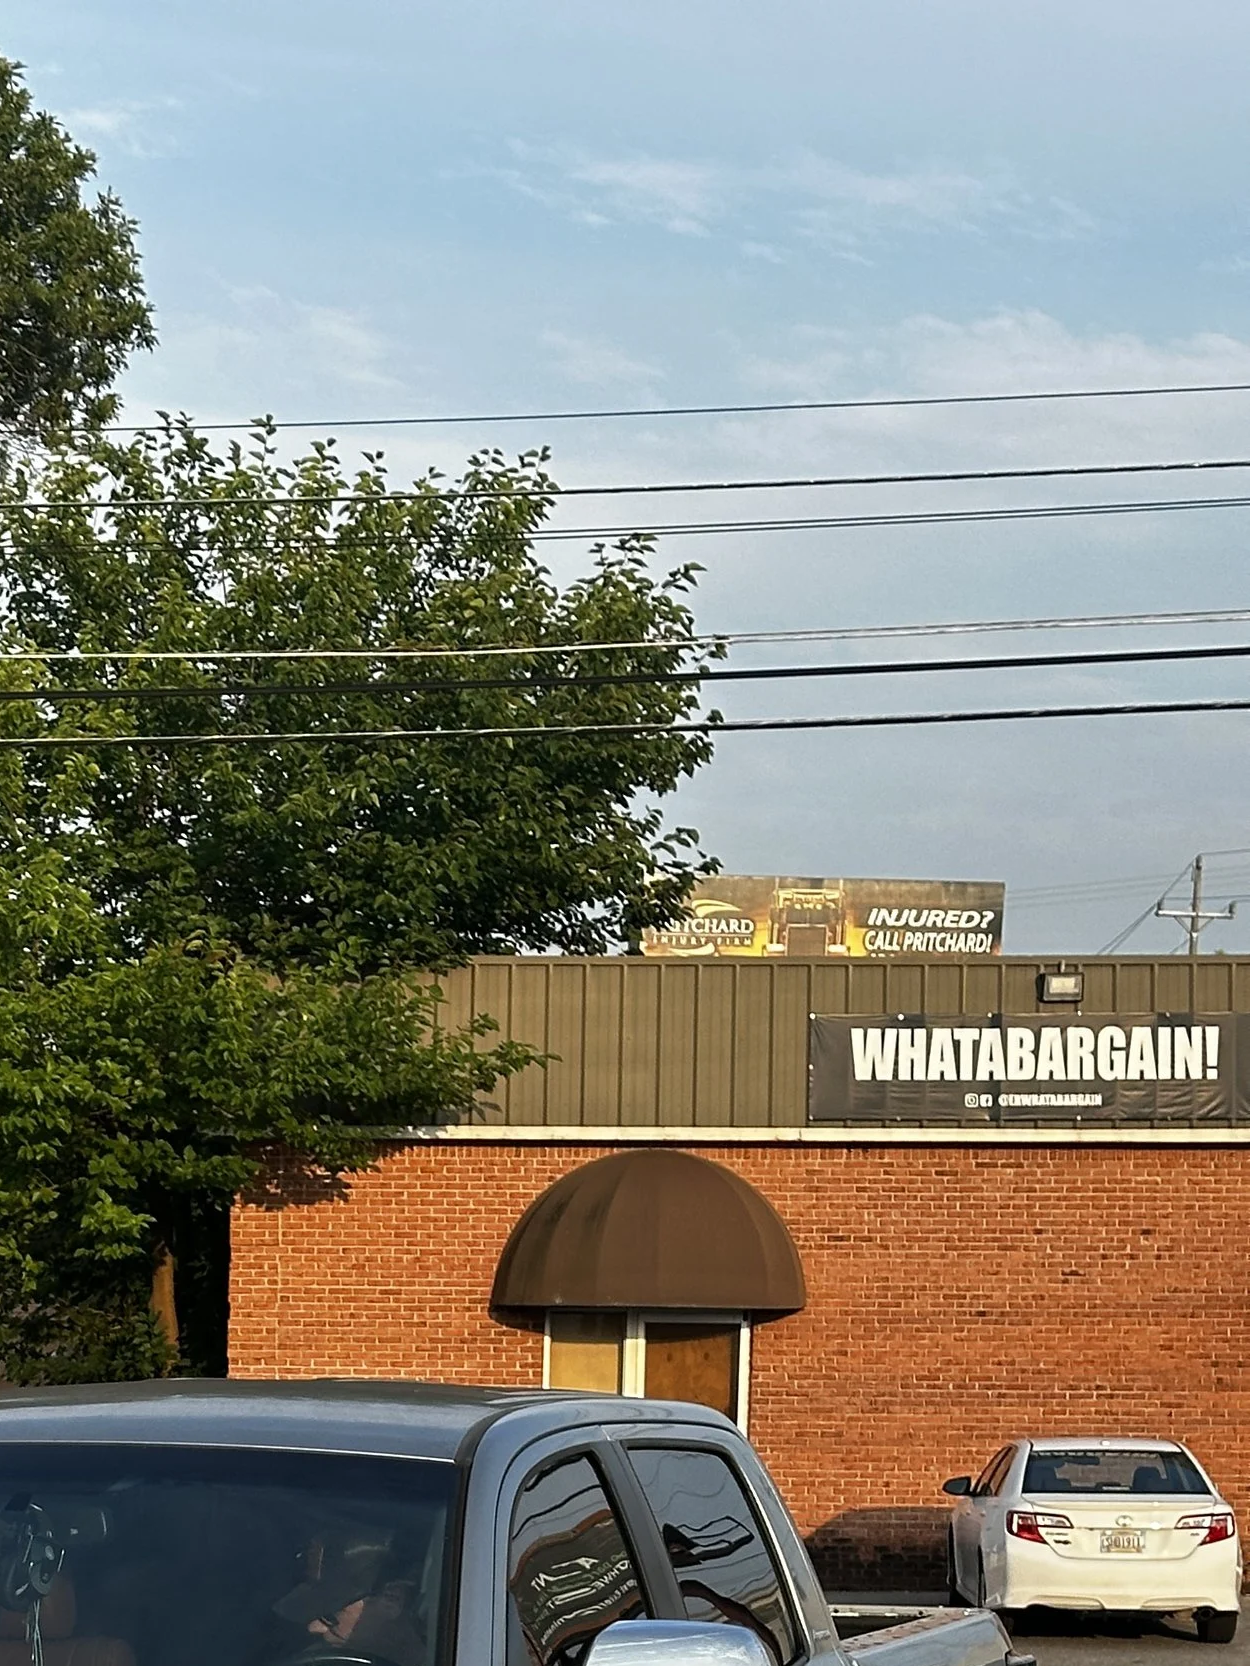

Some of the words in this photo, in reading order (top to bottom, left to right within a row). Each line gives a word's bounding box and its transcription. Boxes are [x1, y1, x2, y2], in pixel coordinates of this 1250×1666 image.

[867, 907, 996, 929] INJURED?
[652, 936, 707, 946] INJURY
[716, 936, 753, 946] FIRM
[864, 930, 901, 951] CALL
[902, 931, 993, 953] PRITCHARD!
[850, 1025, 1221, 1081] WHATABARGAIN!
